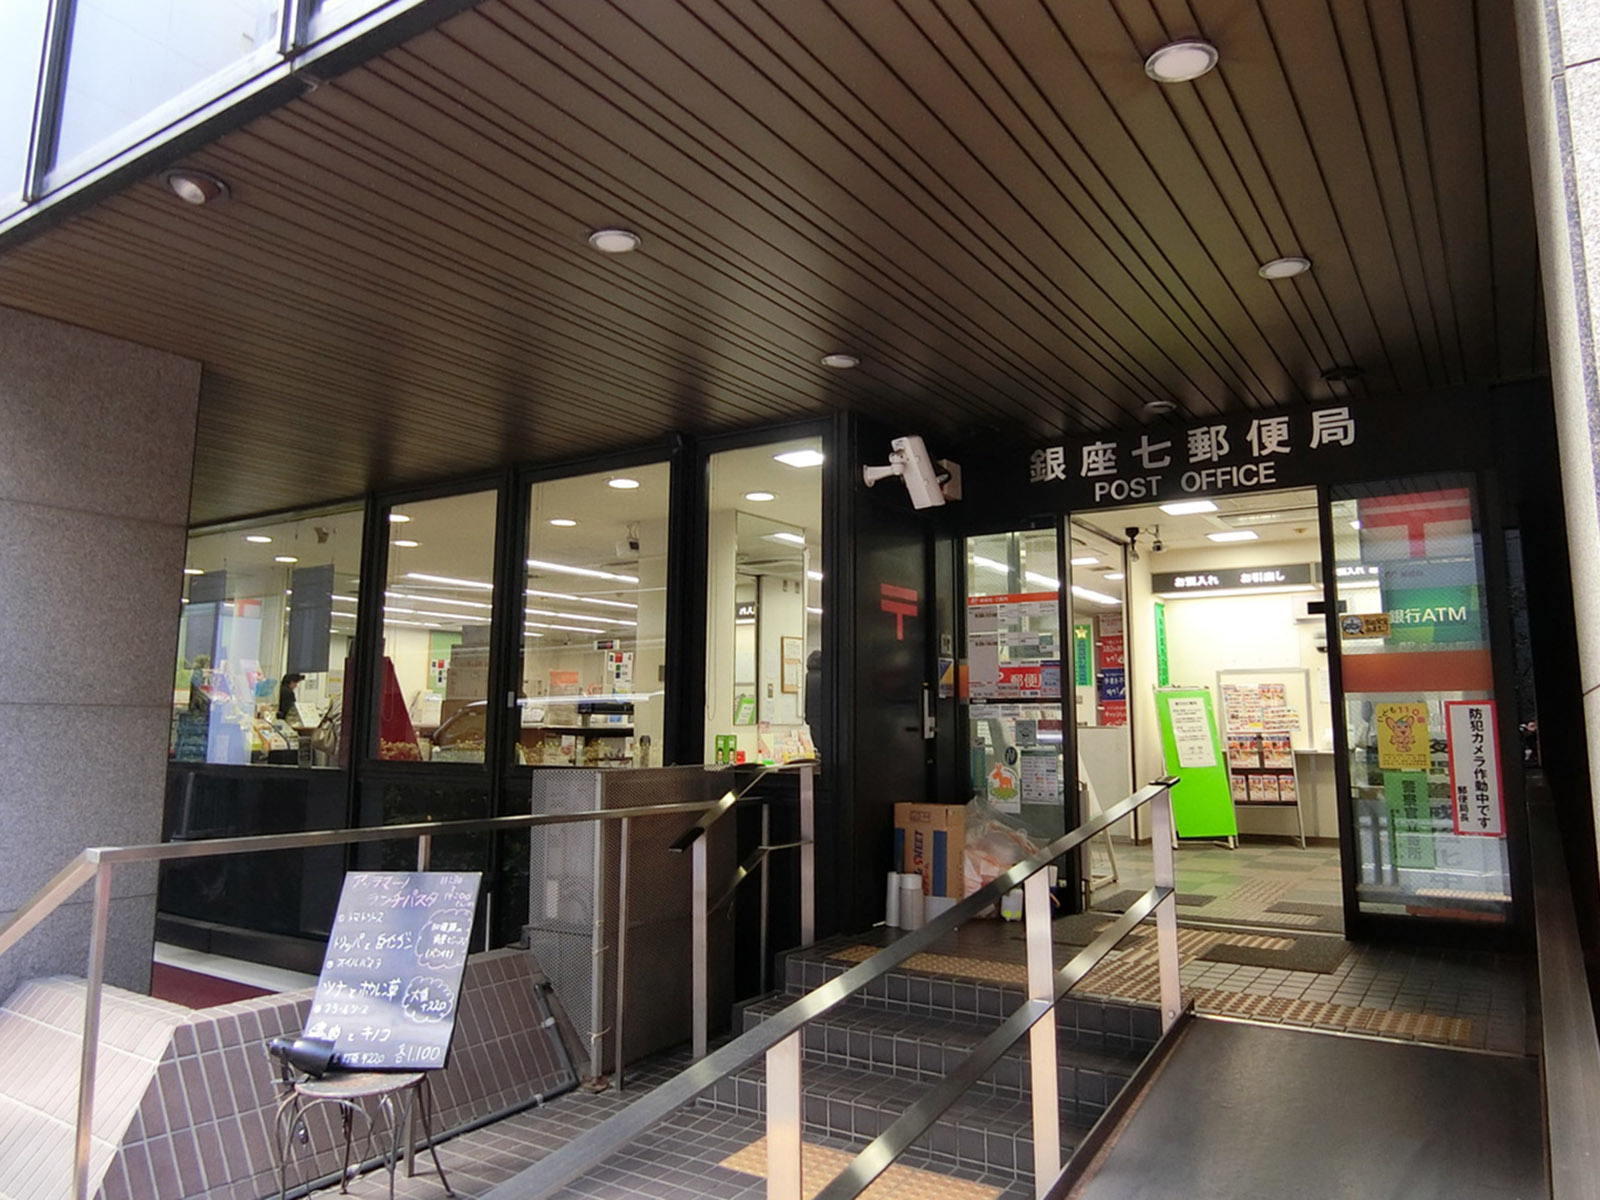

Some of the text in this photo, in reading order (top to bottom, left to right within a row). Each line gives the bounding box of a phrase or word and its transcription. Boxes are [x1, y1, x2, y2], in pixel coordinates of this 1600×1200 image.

[1030, 407, 1355, 483] 銀座七郵便局
[1094, 461, 1276, 502] POST OFFICE
[1240, 570, 1285, 584] お引出し
[1010, 673, 1042, 690] 郵便
[1468, 707, 1492, 829] 防犯カメラ作動中です
[1457, 785, 1470, 823] 郵便局長
[914, 831, 924, 867] SHEET
[369, 889, 439, 909] ランチパスタ
